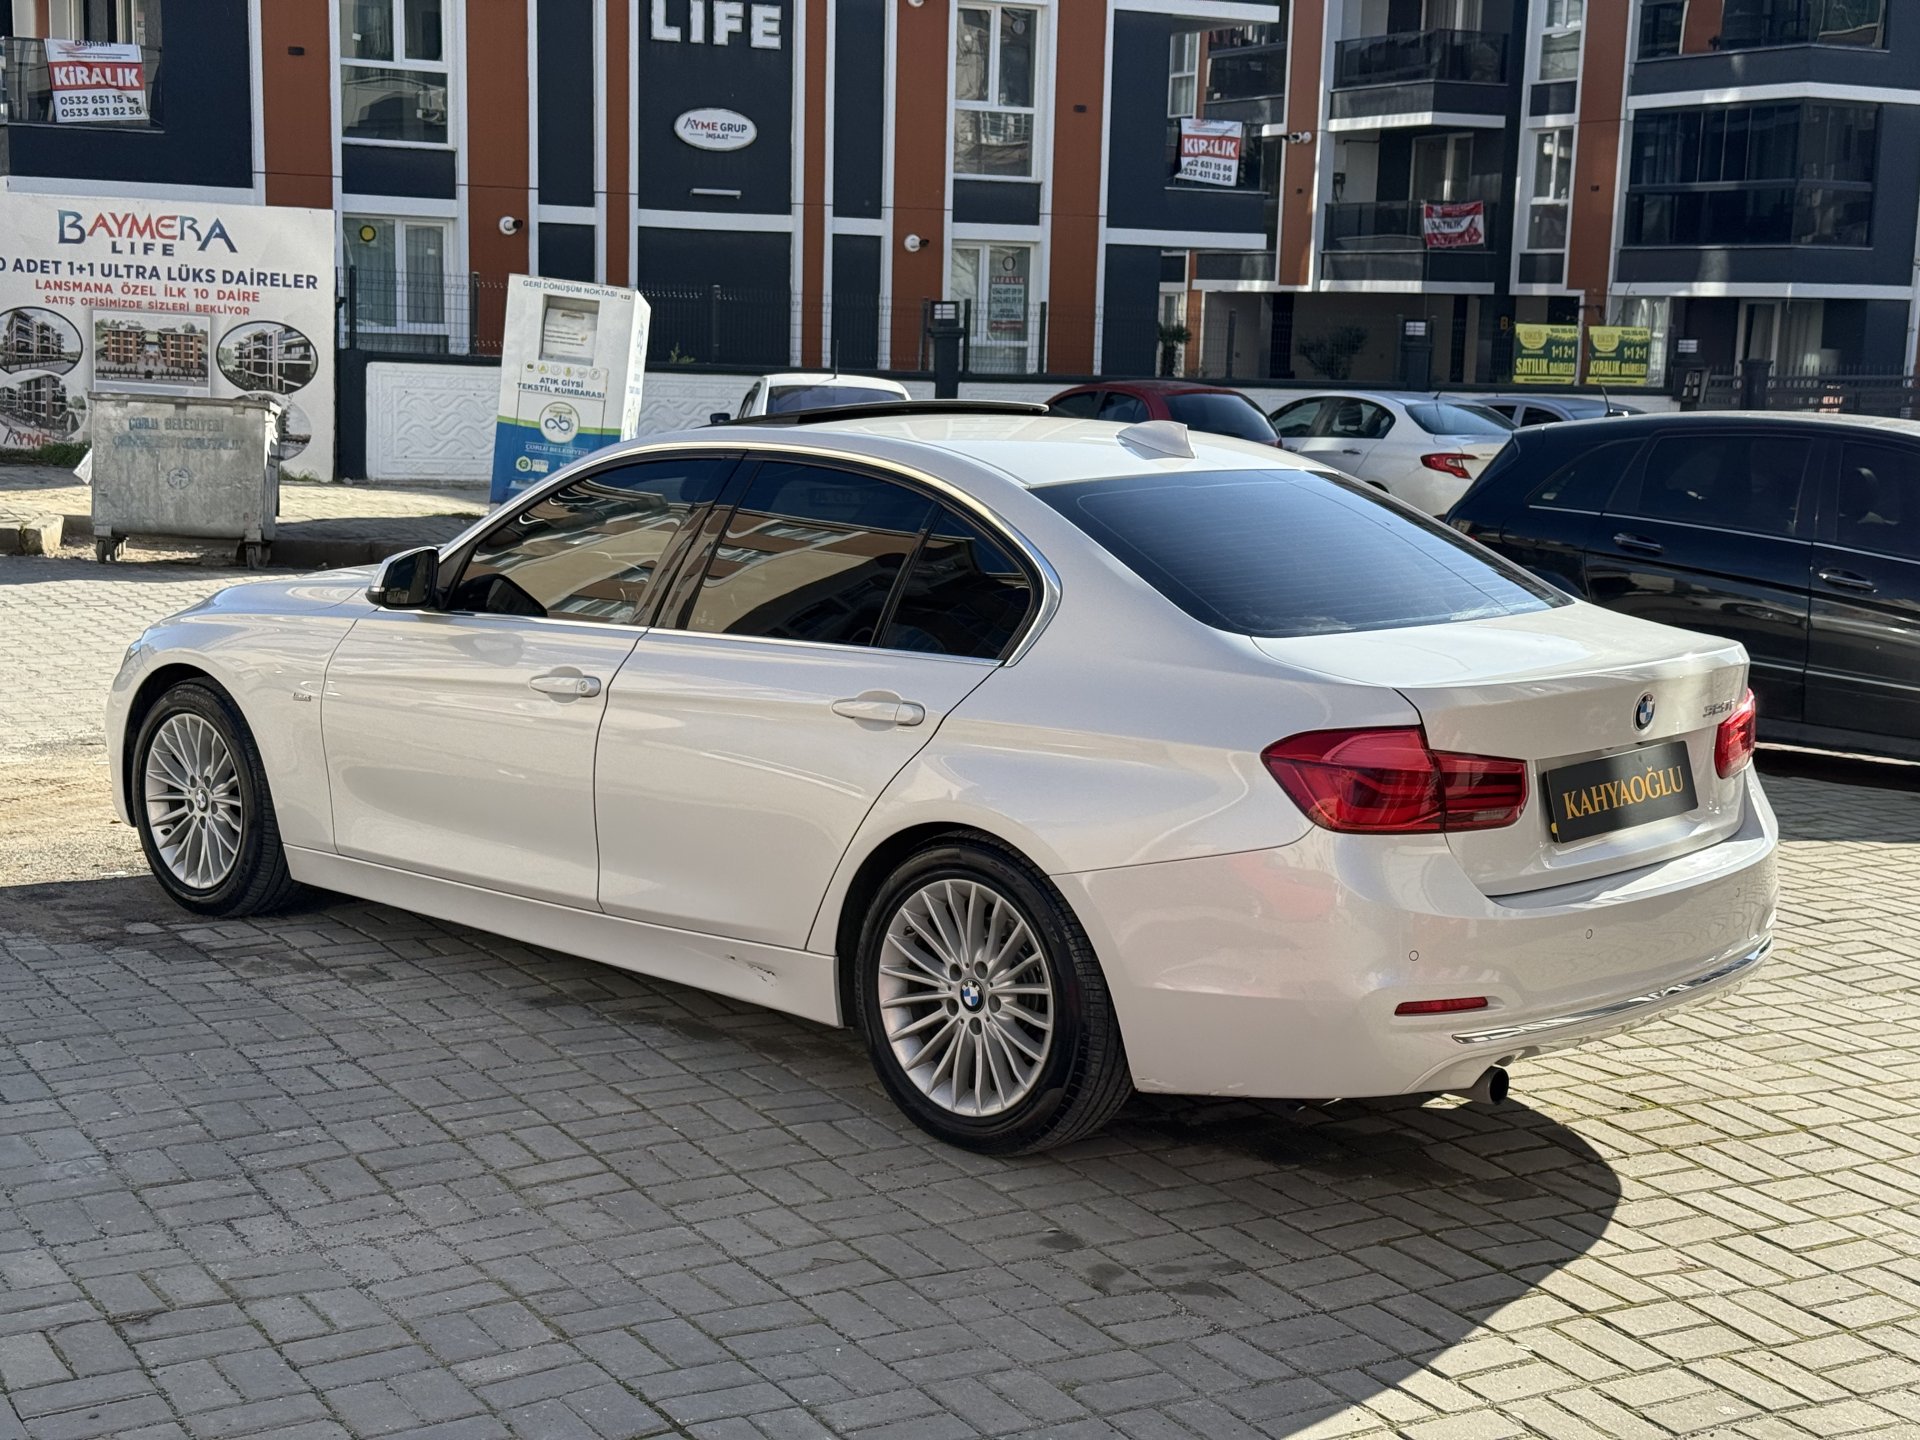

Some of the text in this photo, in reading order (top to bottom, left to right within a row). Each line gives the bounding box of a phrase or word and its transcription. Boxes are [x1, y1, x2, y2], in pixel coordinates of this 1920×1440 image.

[651, 0, 781, 50] LIFE
[60, 96, 88, 105] 0532
[91, 95, 109, 104] 651
[112, 95, 123, 104] 15
[61, 107, 142, 117] 0533 431 82 56
[684, 117, 747, 133] AYME GRUP
[1201, 161, 1212, 169] 651
[1198, 170, 1210, 178] 431
[58, 209, 238, 253] BAYMERA
[111, 241, 174, 256] LIFE
[12, 258, 62, 275] ADET
[68, 261, 94, 276] 1+1
[101, 263, 161, 281] ULTRA
[167, 264, 215, 283] LÜKS
[222, 268, 318, 289] DAİRELER
[35, 279, 260, 302] LANSMANA ÖZEL İLK 10 DAİRE
[584, 288, 617, 297] NOKTASI
[45, 295, 250, 315] SATIŞ OFİSİMİZDE SİZLERİ BEKLİYOR
[1516, 358, 1548, 374] SATILIK
[540, 377, 558, 386] ATIK
[517, 382, 605, 398] TEKSTİL KUMBARASI
[1562, 765, 1684, 820] KAHYAOĞLU
